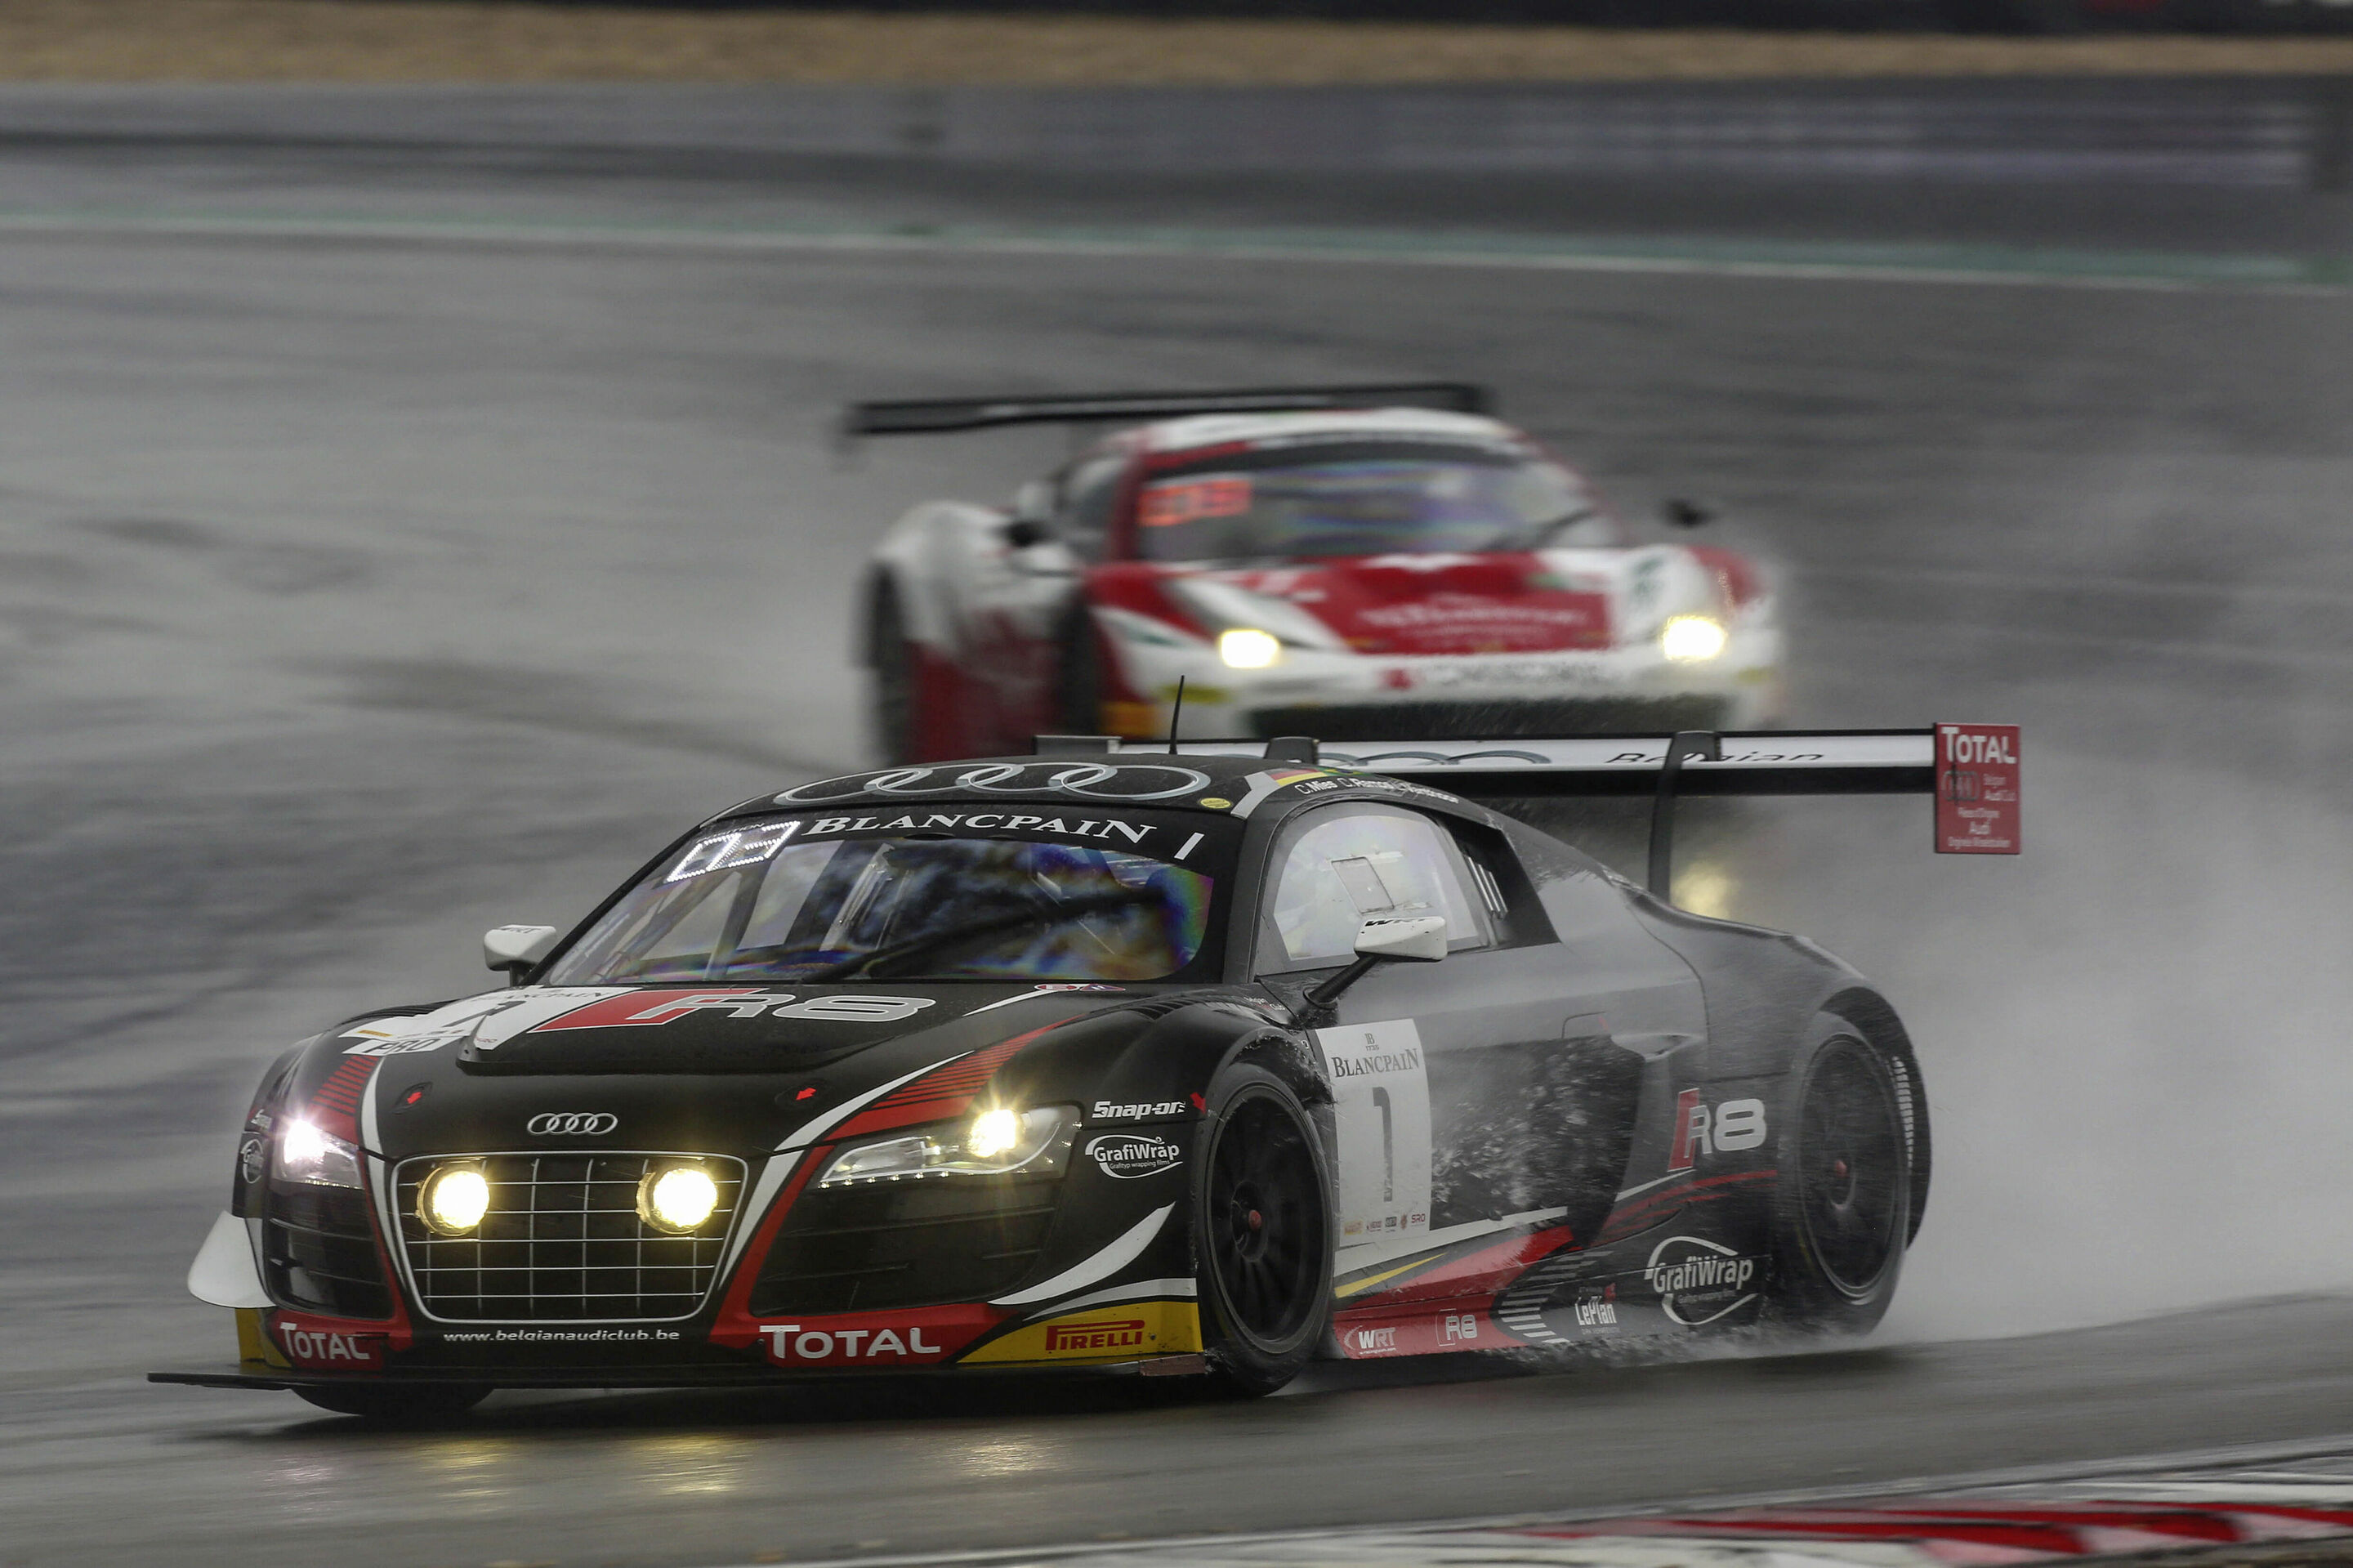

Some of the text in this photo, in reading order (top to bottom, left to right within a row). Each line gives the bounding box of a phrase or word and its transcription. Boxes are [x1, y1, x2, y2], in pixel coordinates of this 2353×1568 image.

[1941, 726, 2017, 764] TOTAL
[801, 815, 1157, 844] BLANCPAIN
[624, 993, 936, 1021] R8
[364, 1039, 441, 1054] PRO
[1331, 1048, 1419, 1078] BLANCPAIN
[1682, 1098, 1767, 1159] R8
[1093, 1144, 1180, 1162] GrafiWrap
[1373, 1087, 1393, 1202] 1
[1653, 1255, 1754, 1293] GrafiWrap
[279, 1322, 370, 1360] TOTAL
[443, 1329, 680, 1341] www.belgianaudiclub.be
[758, 1325, 941, 1360] TOTAL
[1045, 1319, 1145, 1351] PIRELLI
[1358, 1327, 1396, 1349] WRT
[1445, 1314, 1478, 1341] R8
